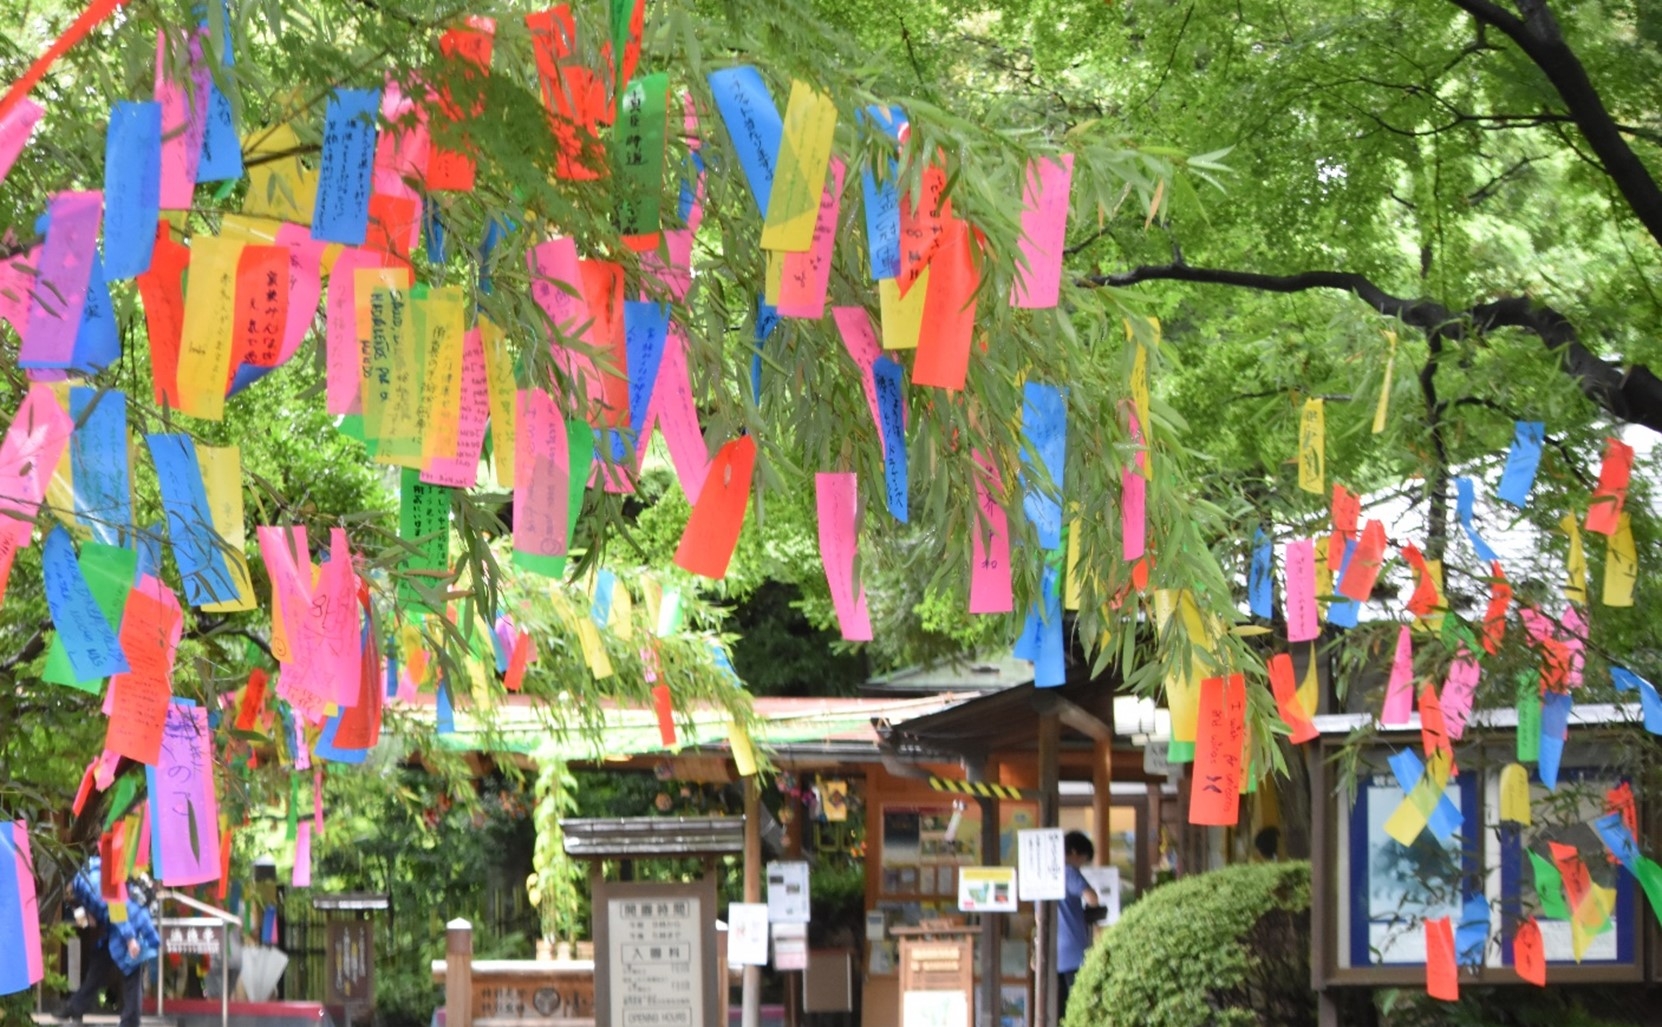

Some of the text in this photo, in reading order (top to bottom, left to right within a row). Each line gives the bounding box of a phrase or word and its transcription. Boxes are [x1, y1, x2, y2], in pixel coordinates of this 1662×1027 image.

[1231, 701, 1241, 711] I
[1230, 718, 1241, 742] wish
[632, 947, 680, 959] 入園料
[628, 1011, 687, 1024] OPENING HOURS
